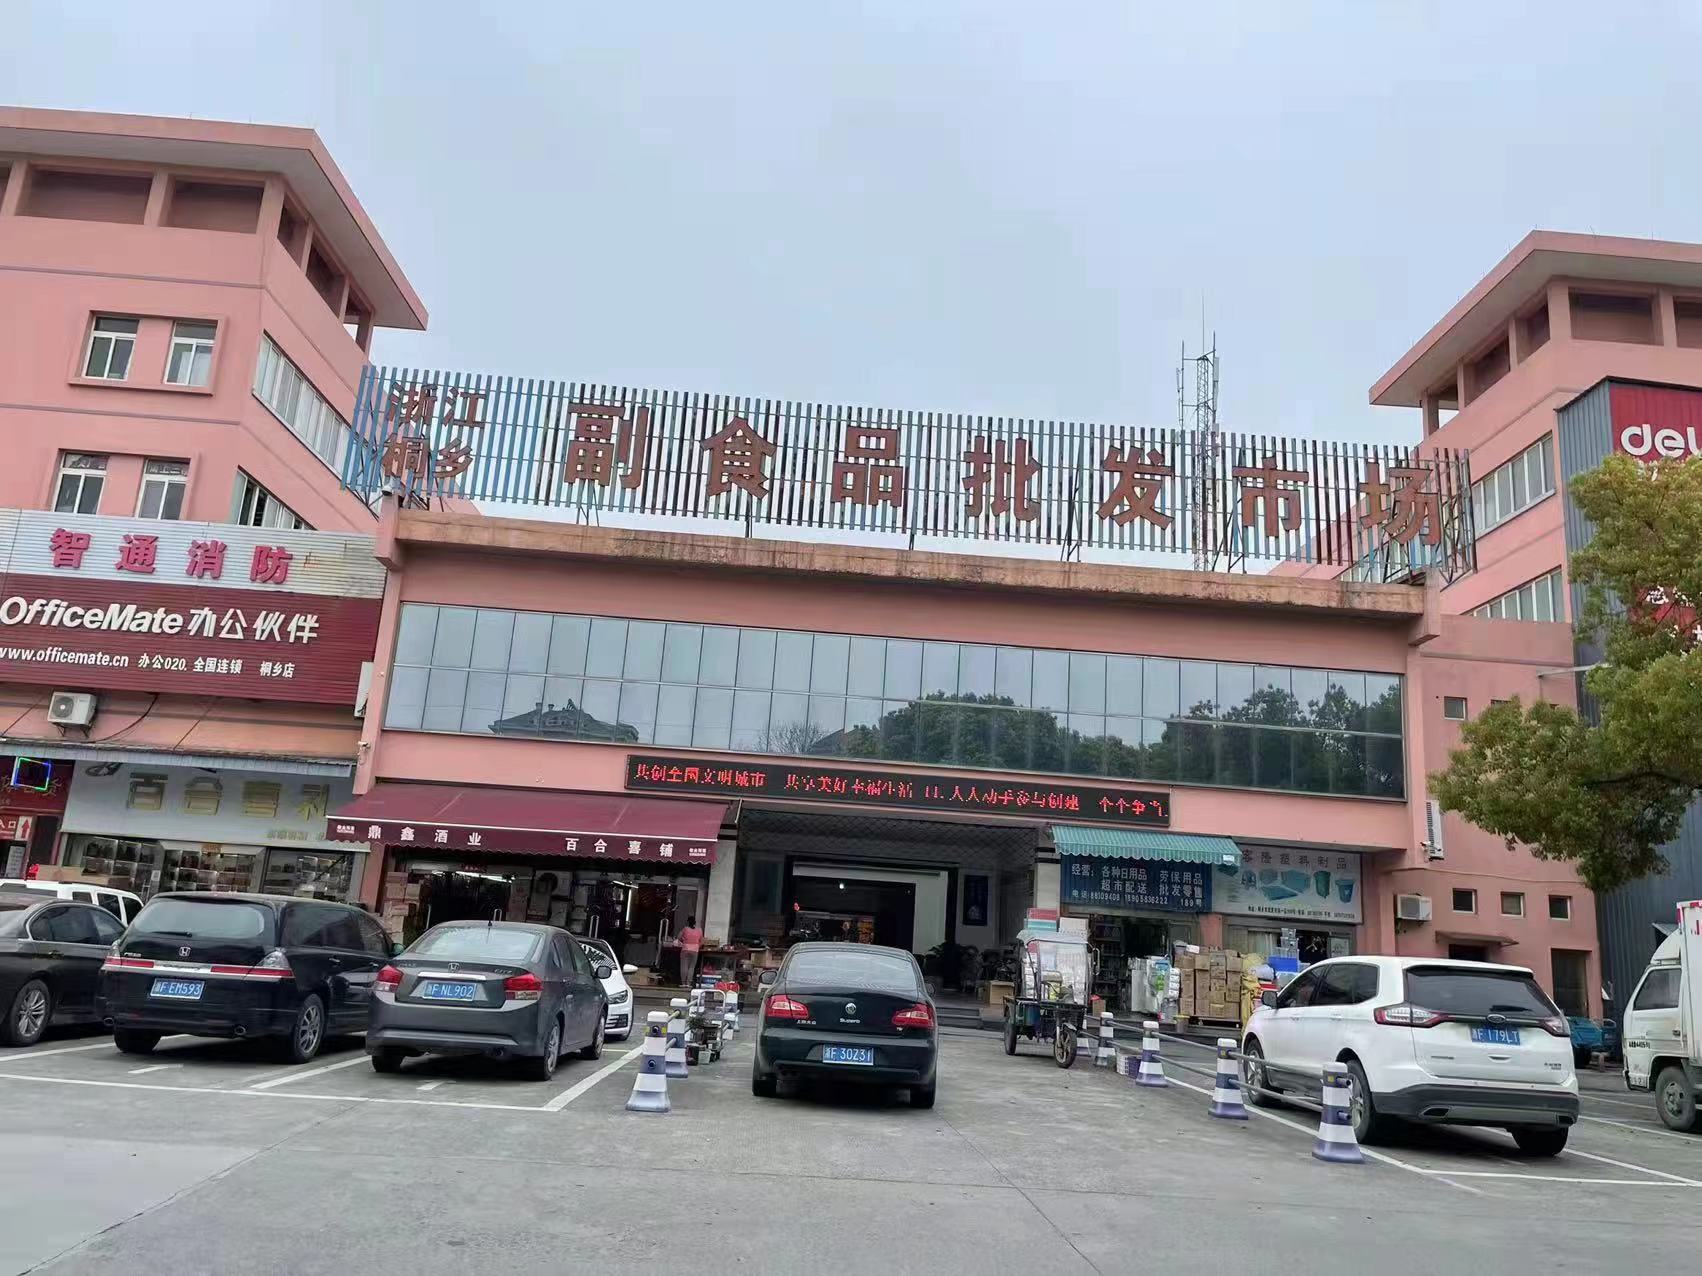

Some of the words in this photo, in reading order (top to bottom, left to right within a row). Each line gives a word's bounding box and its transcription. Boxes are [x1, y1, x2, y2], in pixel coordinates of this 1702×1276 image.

[387, 381, 485, 429] 浙江
[381, 433, 473, 479] 桐乡
[565, 401, 1439, 545] 副食品批发市场
[49, 527, 293, 585] 智通消防
[0, 596, 184, 634] OfficeMate
[187, 606, 320, 644] 办公伙伴
[193, 656, 243, 674] 全国连锁
[259, 661, 295, 678] 桐乡店
[367, 824, 482, 846] 鼎鑫酒业
[565, 837, 674, 858] 百合喜铺
[1101, 866, 1148, 881] 各种日用品
[1159, 870, 1203, 885] 劳保用品
[1101, 880, 1148, 894] 超市配送
[1159, 884, 1203, 899] 批发零售
